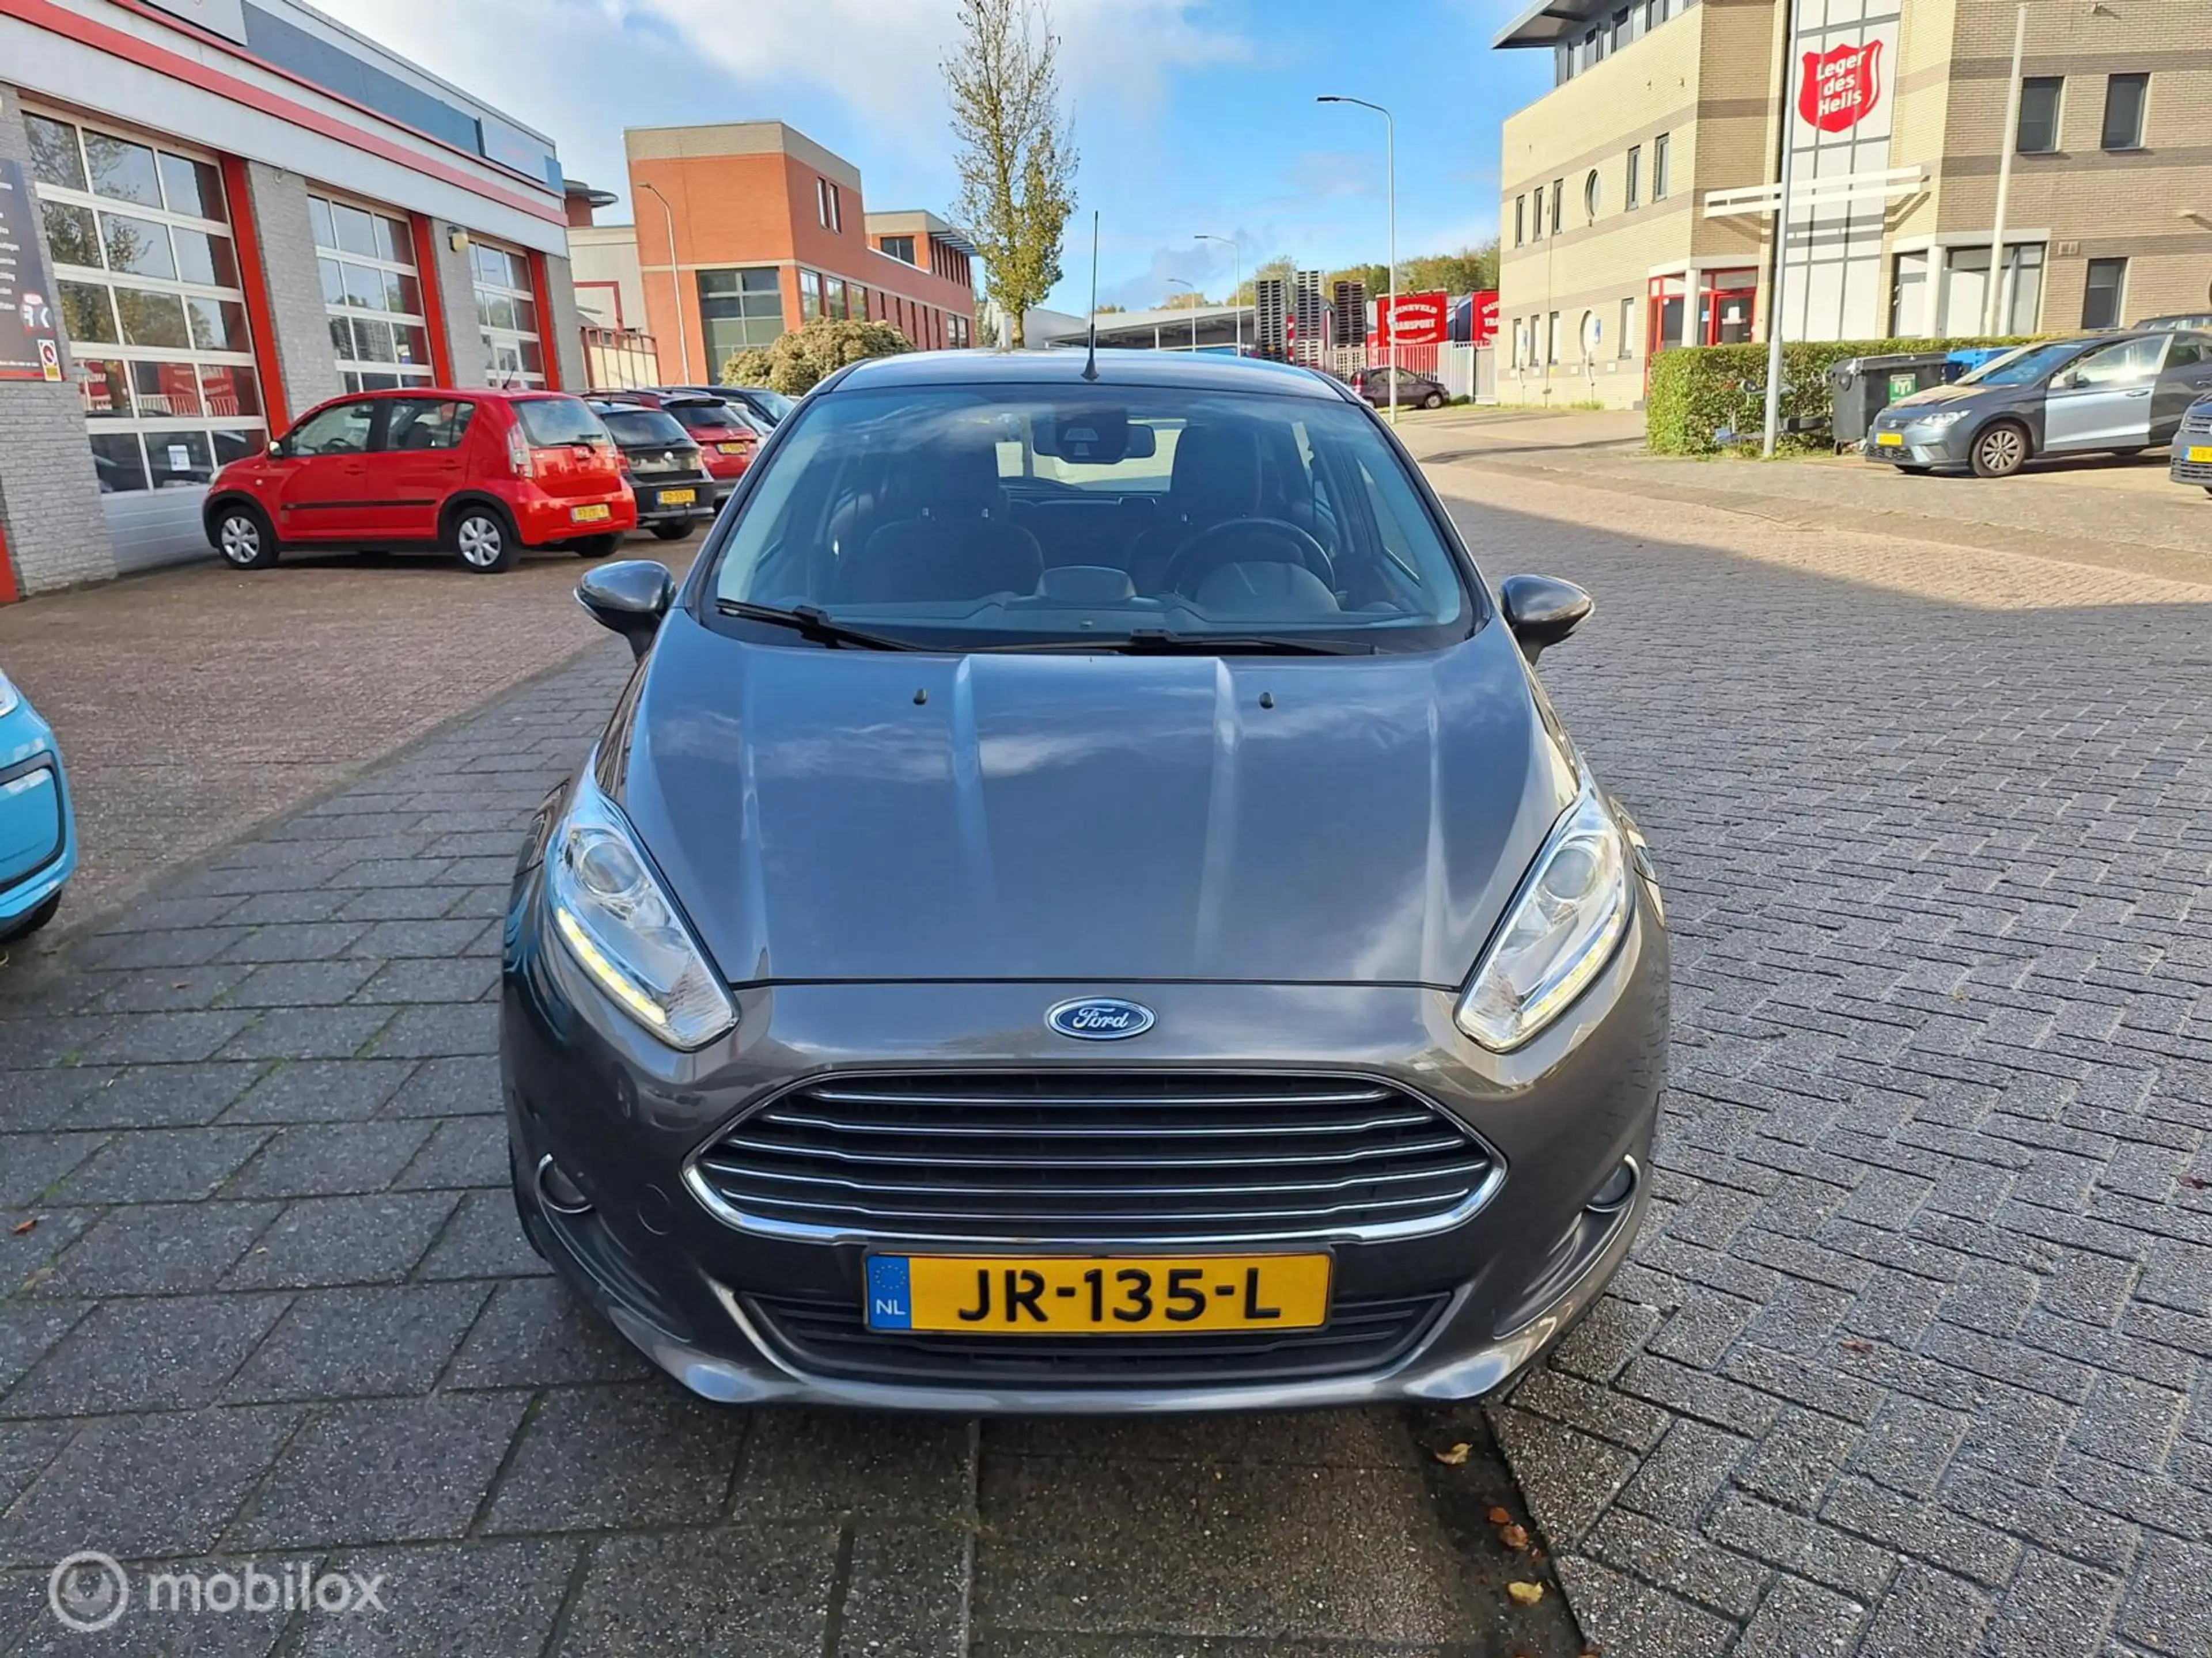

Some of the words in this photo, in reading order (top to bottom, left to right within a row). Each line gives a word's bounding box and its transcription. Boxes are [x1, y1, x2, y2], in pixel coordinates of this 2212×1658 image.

[1816, 51, 1866, 81] Leger
[1823, 74, 1855, 96] des
[1387, 304, 1438, 315] UINEVELD
[1073, 1007, 1130, 1028] Ford
[876, 1299, 906, 1315] NL
[958, 1268, 1281, 1322] JR-135-L
